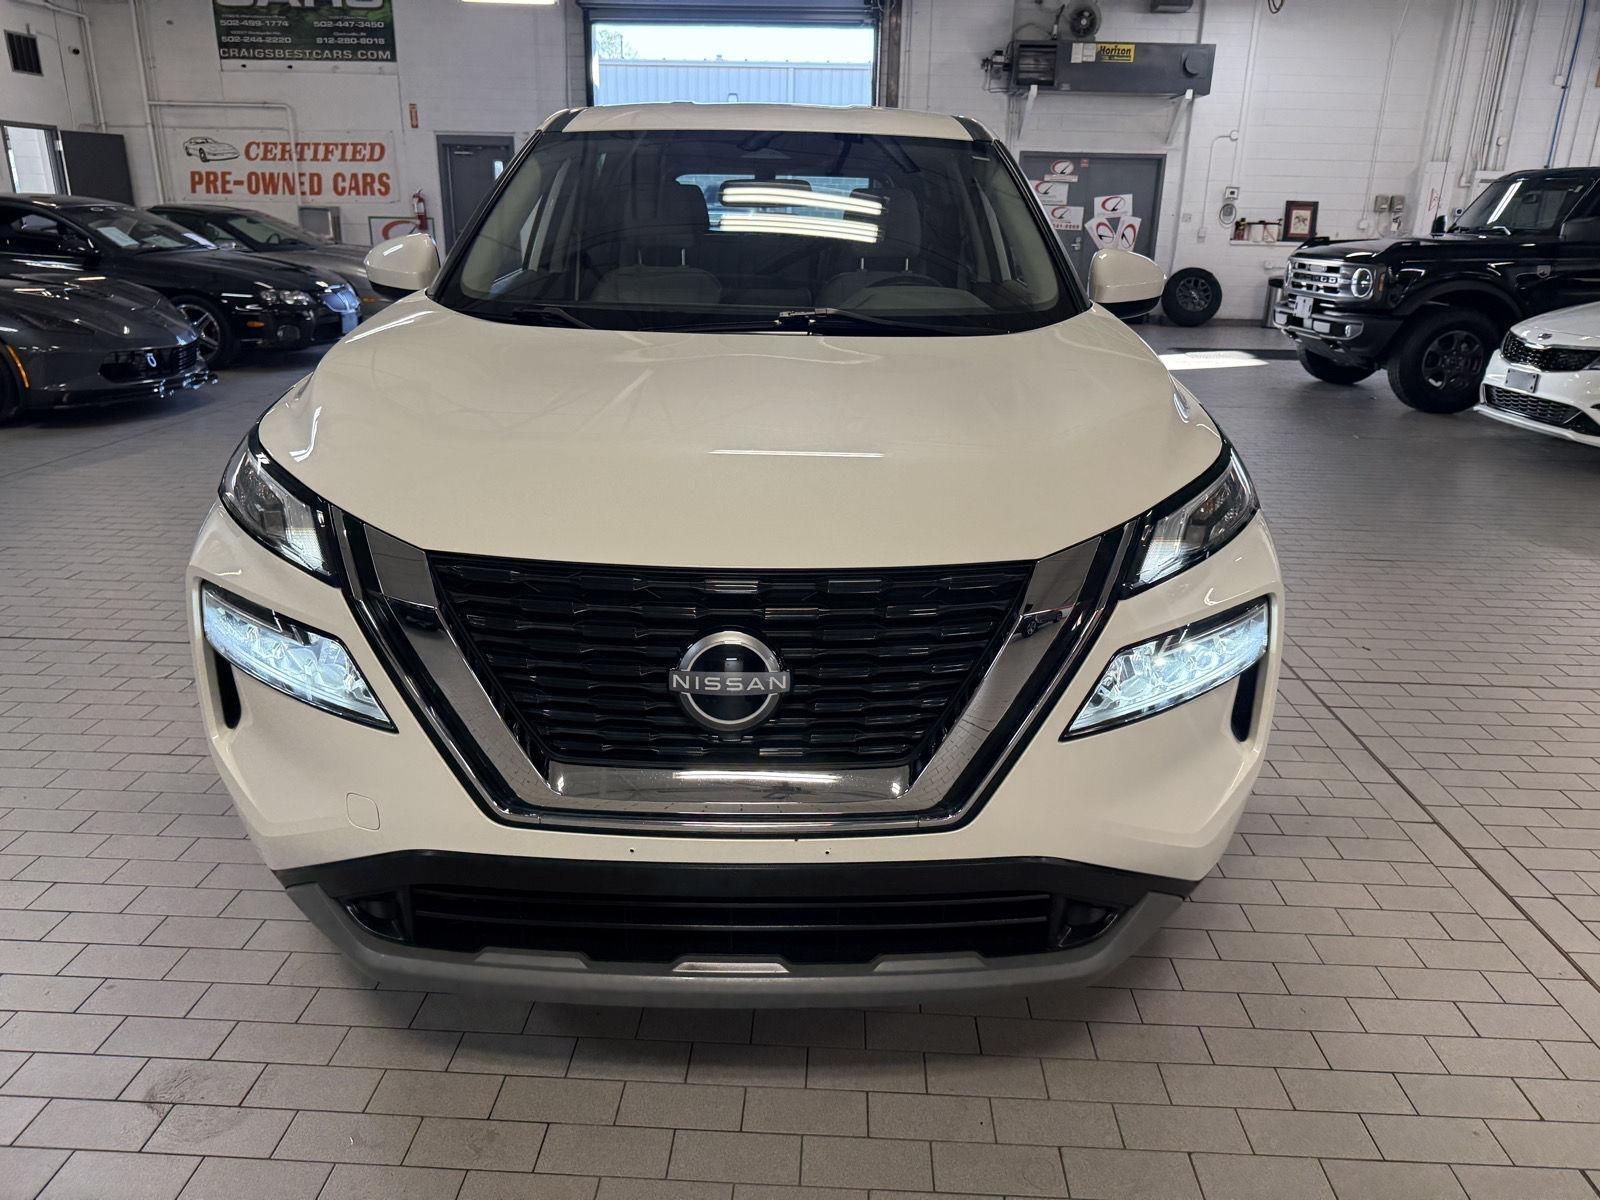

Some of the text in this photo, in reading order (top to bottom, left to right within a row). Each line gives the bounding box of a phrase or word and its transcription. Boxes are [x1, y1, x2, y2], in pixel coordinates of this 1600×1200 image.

[1099, 45, 1132, 55] Horizon
[244, 141, 386, 162] CERTIFIED
[190, 171, 391, 197] PRE-OWNED CARS
[672, 674, 787, 691] NISSAN
